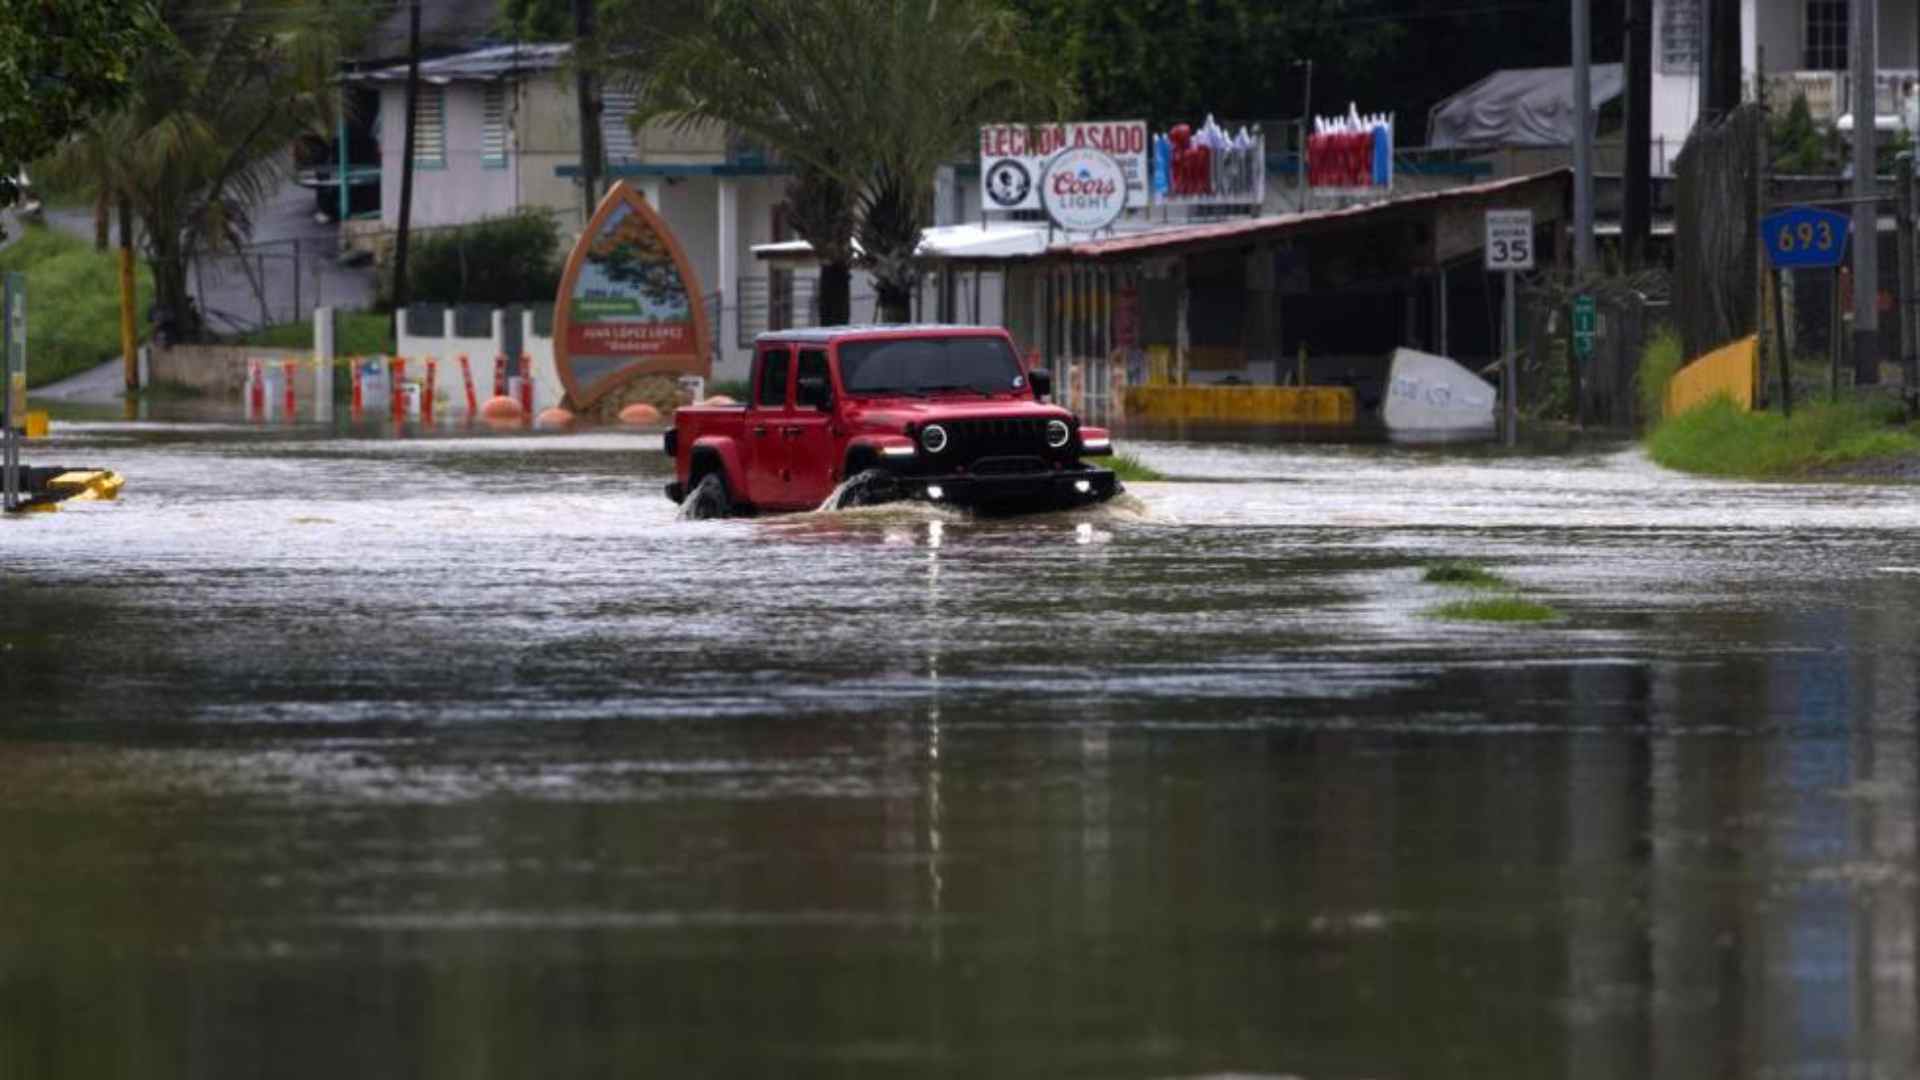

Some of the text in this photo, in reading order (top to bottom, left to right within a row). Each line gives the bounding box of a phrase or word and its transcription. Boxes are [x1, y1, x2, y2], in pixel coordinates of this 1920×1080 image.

[1073, 125, 1143, 154] ASADO
[1053, 171, 1115, 197] Coors
[1060, 195, 1109, 209] LIGHT
[1778, 221, 1832, 252] 693
[1492, 240, 1528, 262] 35
